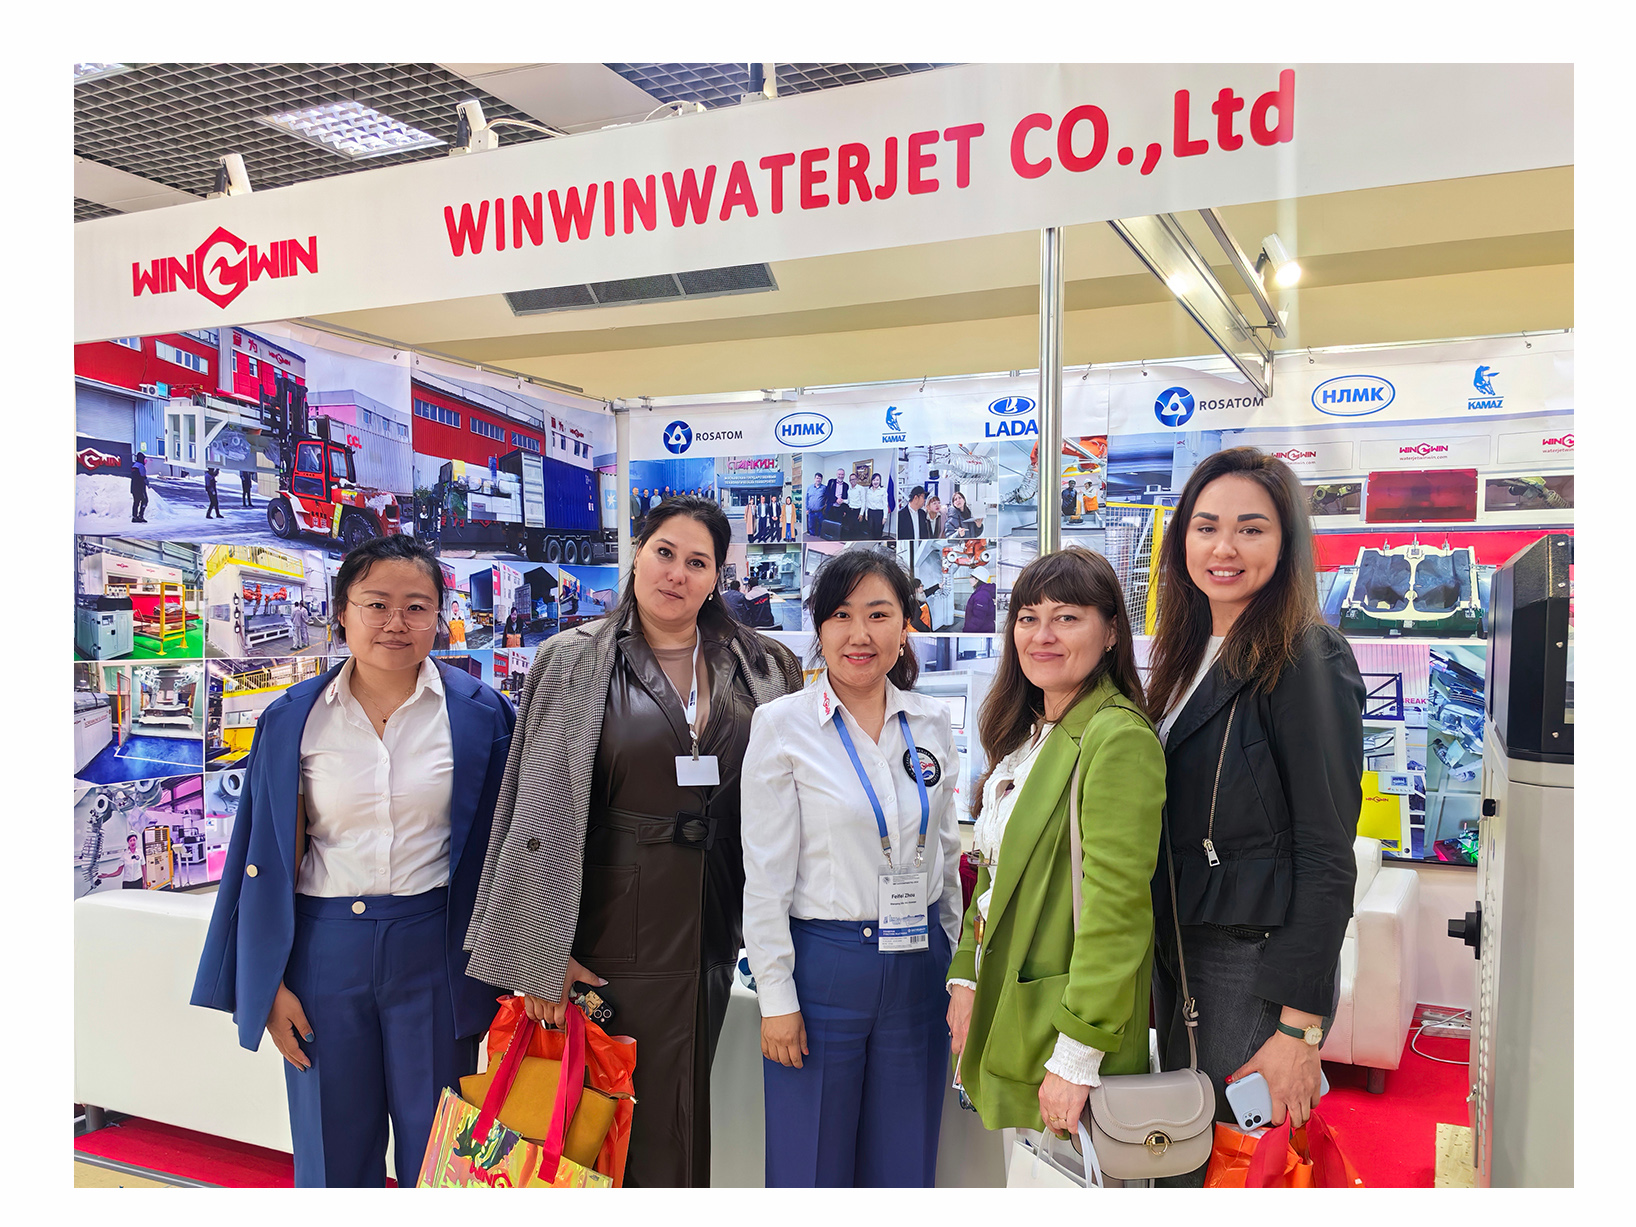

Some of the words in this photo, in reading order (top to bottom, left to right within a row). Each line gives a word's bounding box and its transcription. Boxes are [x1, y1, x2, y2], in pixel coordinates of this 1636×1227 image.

[444, 122, 985, 257] WINWINWATERJET
[1322, 387, 1385, 404] НЛМК
[1199, 397, 1264, 411] ROSATOM
[1468, 400, 1504, 410] KAMAZ
[781, 422, 826, 437] НЛМК
[985, 419, 1039, 438] LADA
[695, 430, 743, 442] ROSATOM
[882, 434, 906, 443] KAMAZ
